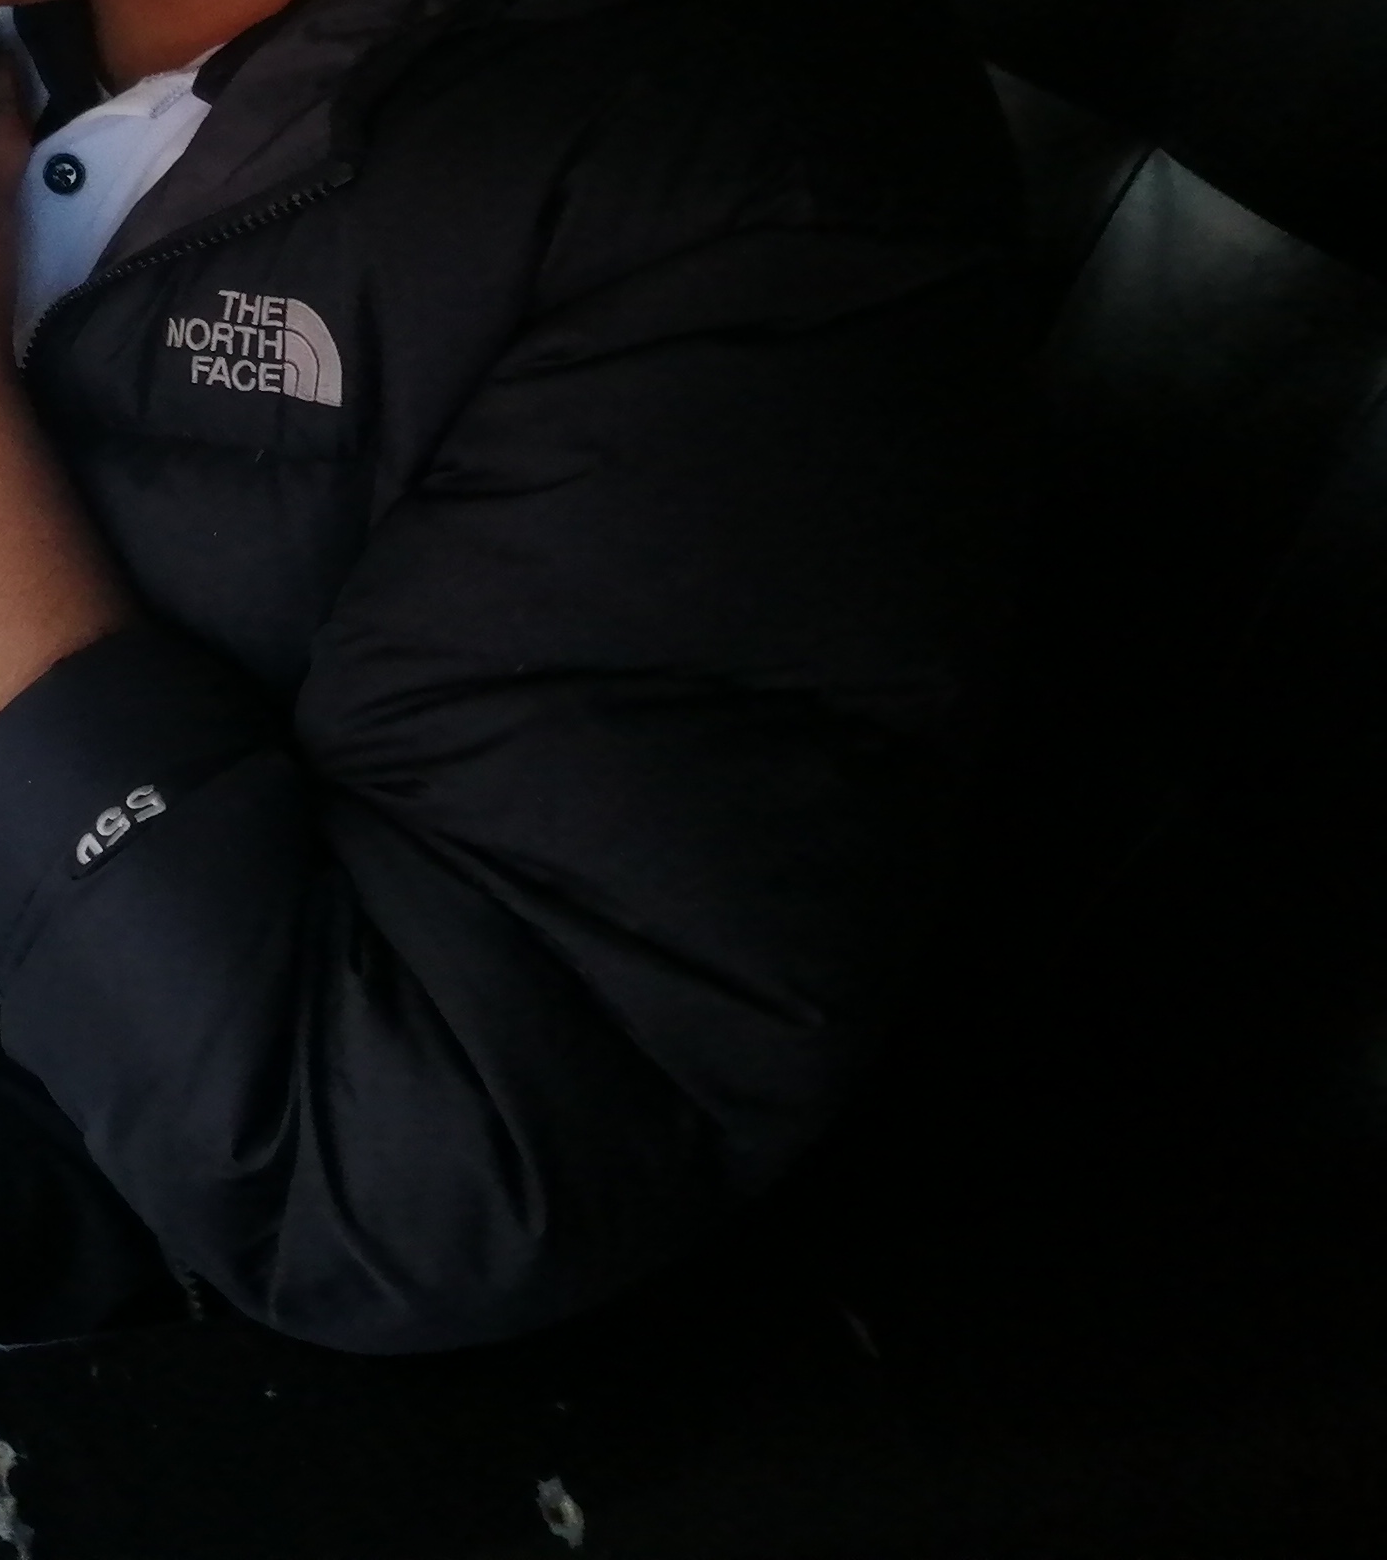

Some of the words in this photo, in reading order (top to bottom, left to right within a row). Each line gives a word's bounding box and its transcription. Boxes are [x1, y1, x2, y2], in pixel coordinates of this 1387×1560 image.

[217, 289, 286, 328] THE
[166, 316, 284, 361] NORTH
[191, 355, 283, 394] FACE
